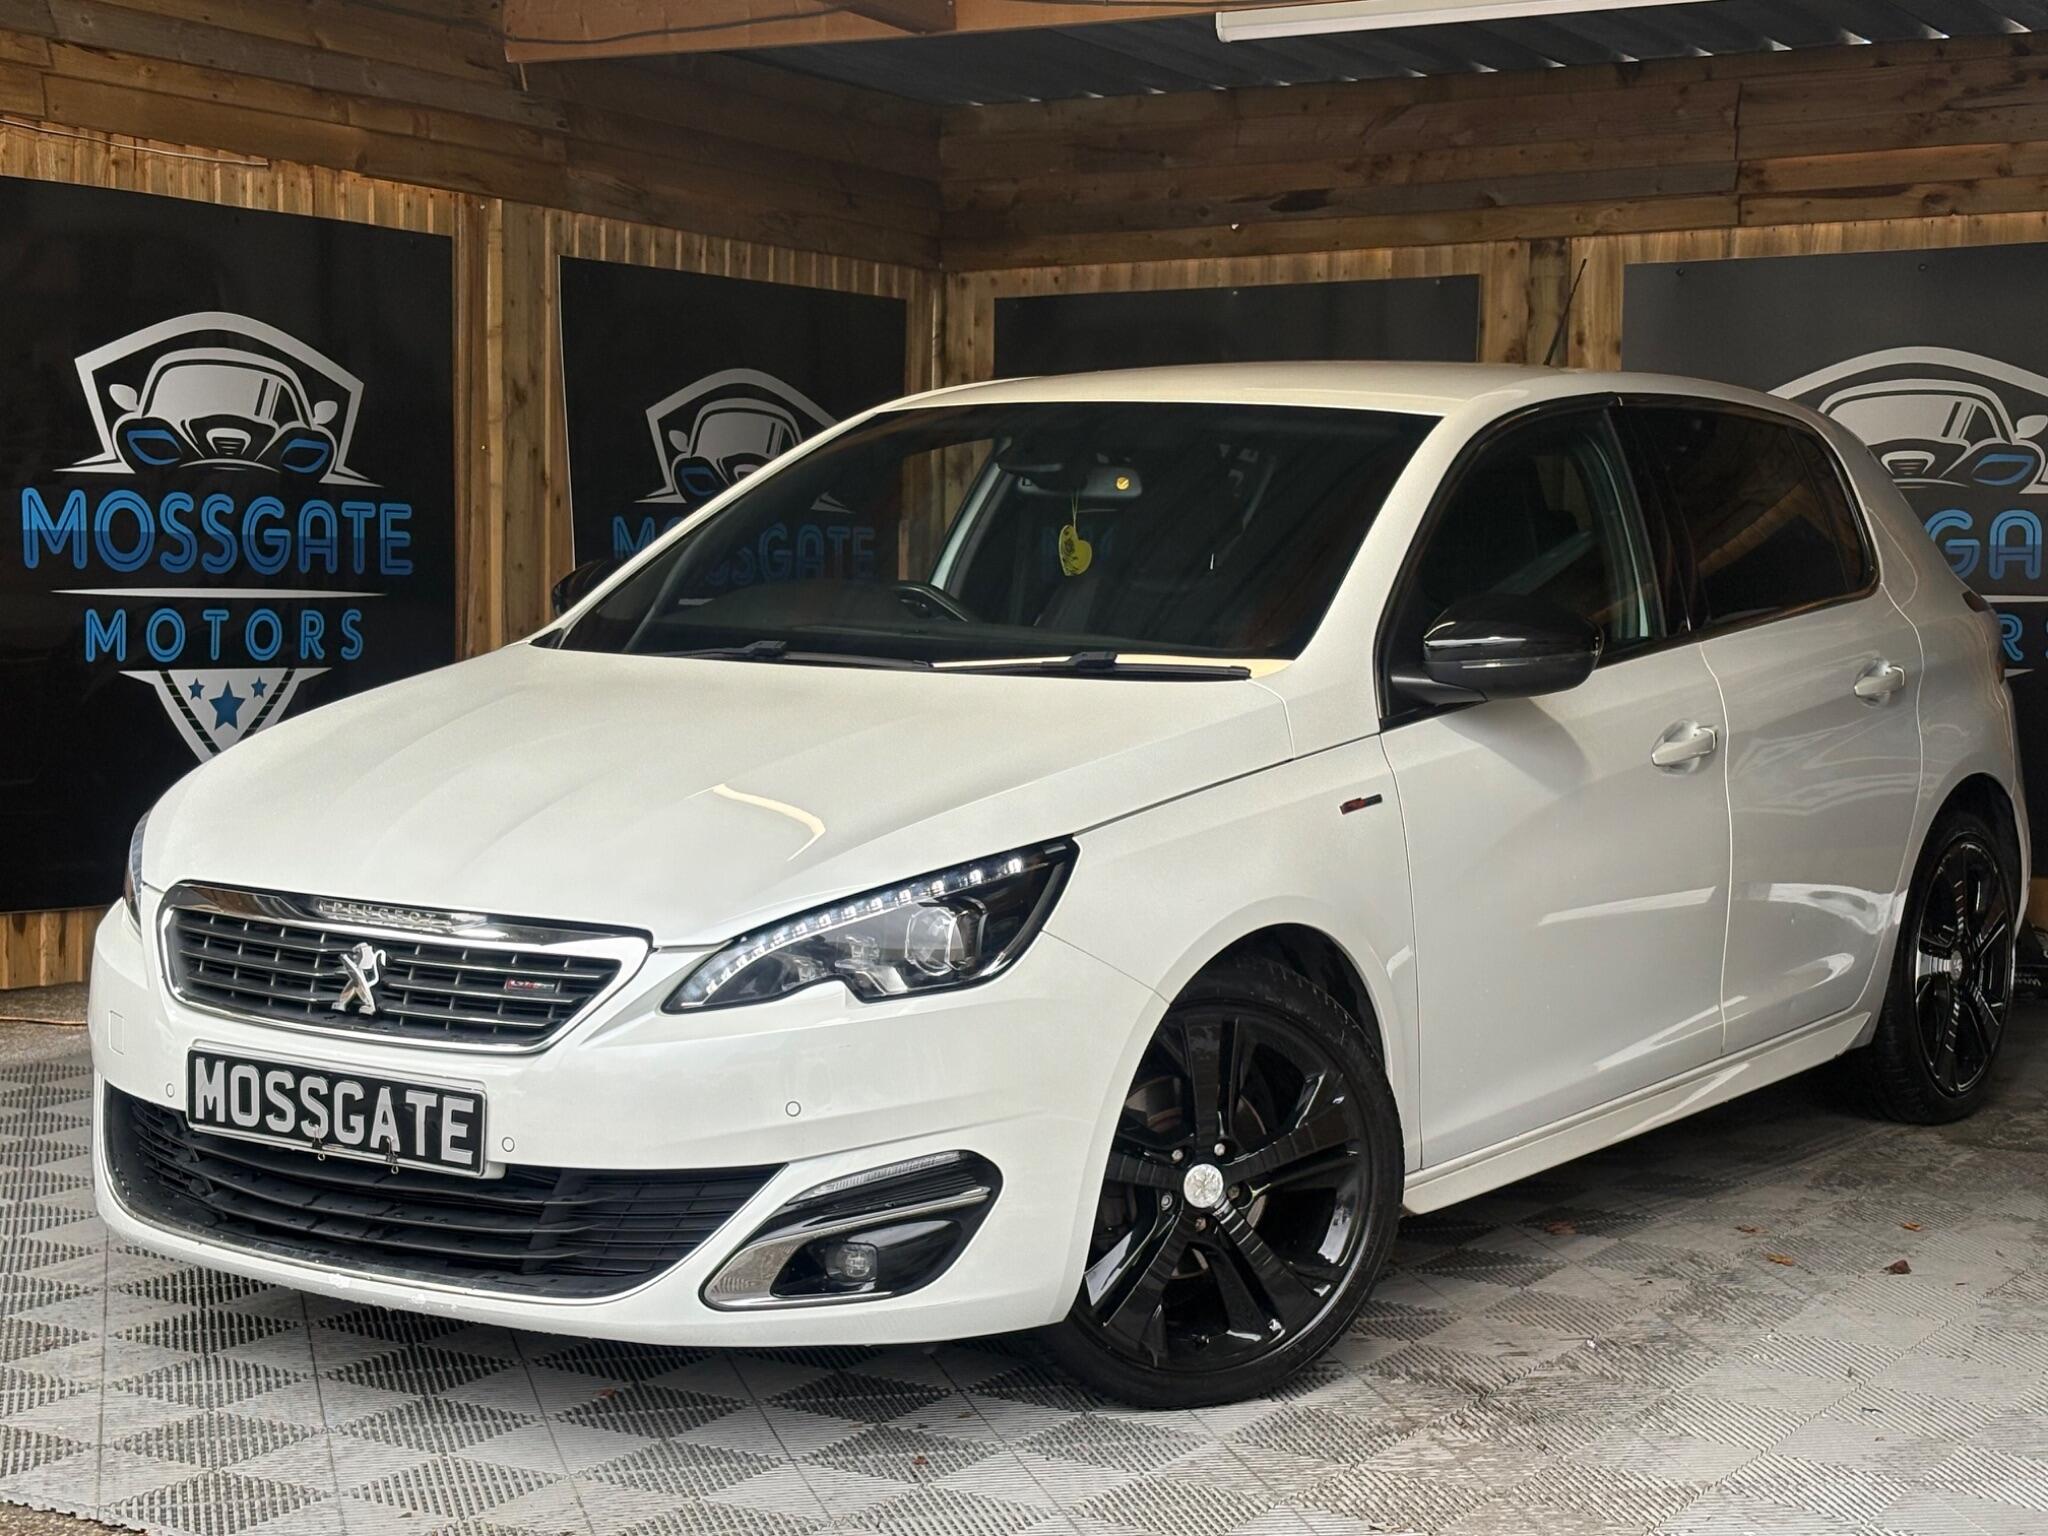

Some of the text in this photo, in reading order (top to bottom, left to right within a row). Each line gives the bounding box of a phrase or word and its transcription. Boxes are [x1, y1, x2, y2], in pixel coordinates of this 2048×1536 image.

[21, 487, 413, 576] MOSSGATE
[85, 608, 364, 663] MOTORS
[194, 1056, 474, 1164] MOSSGATE
